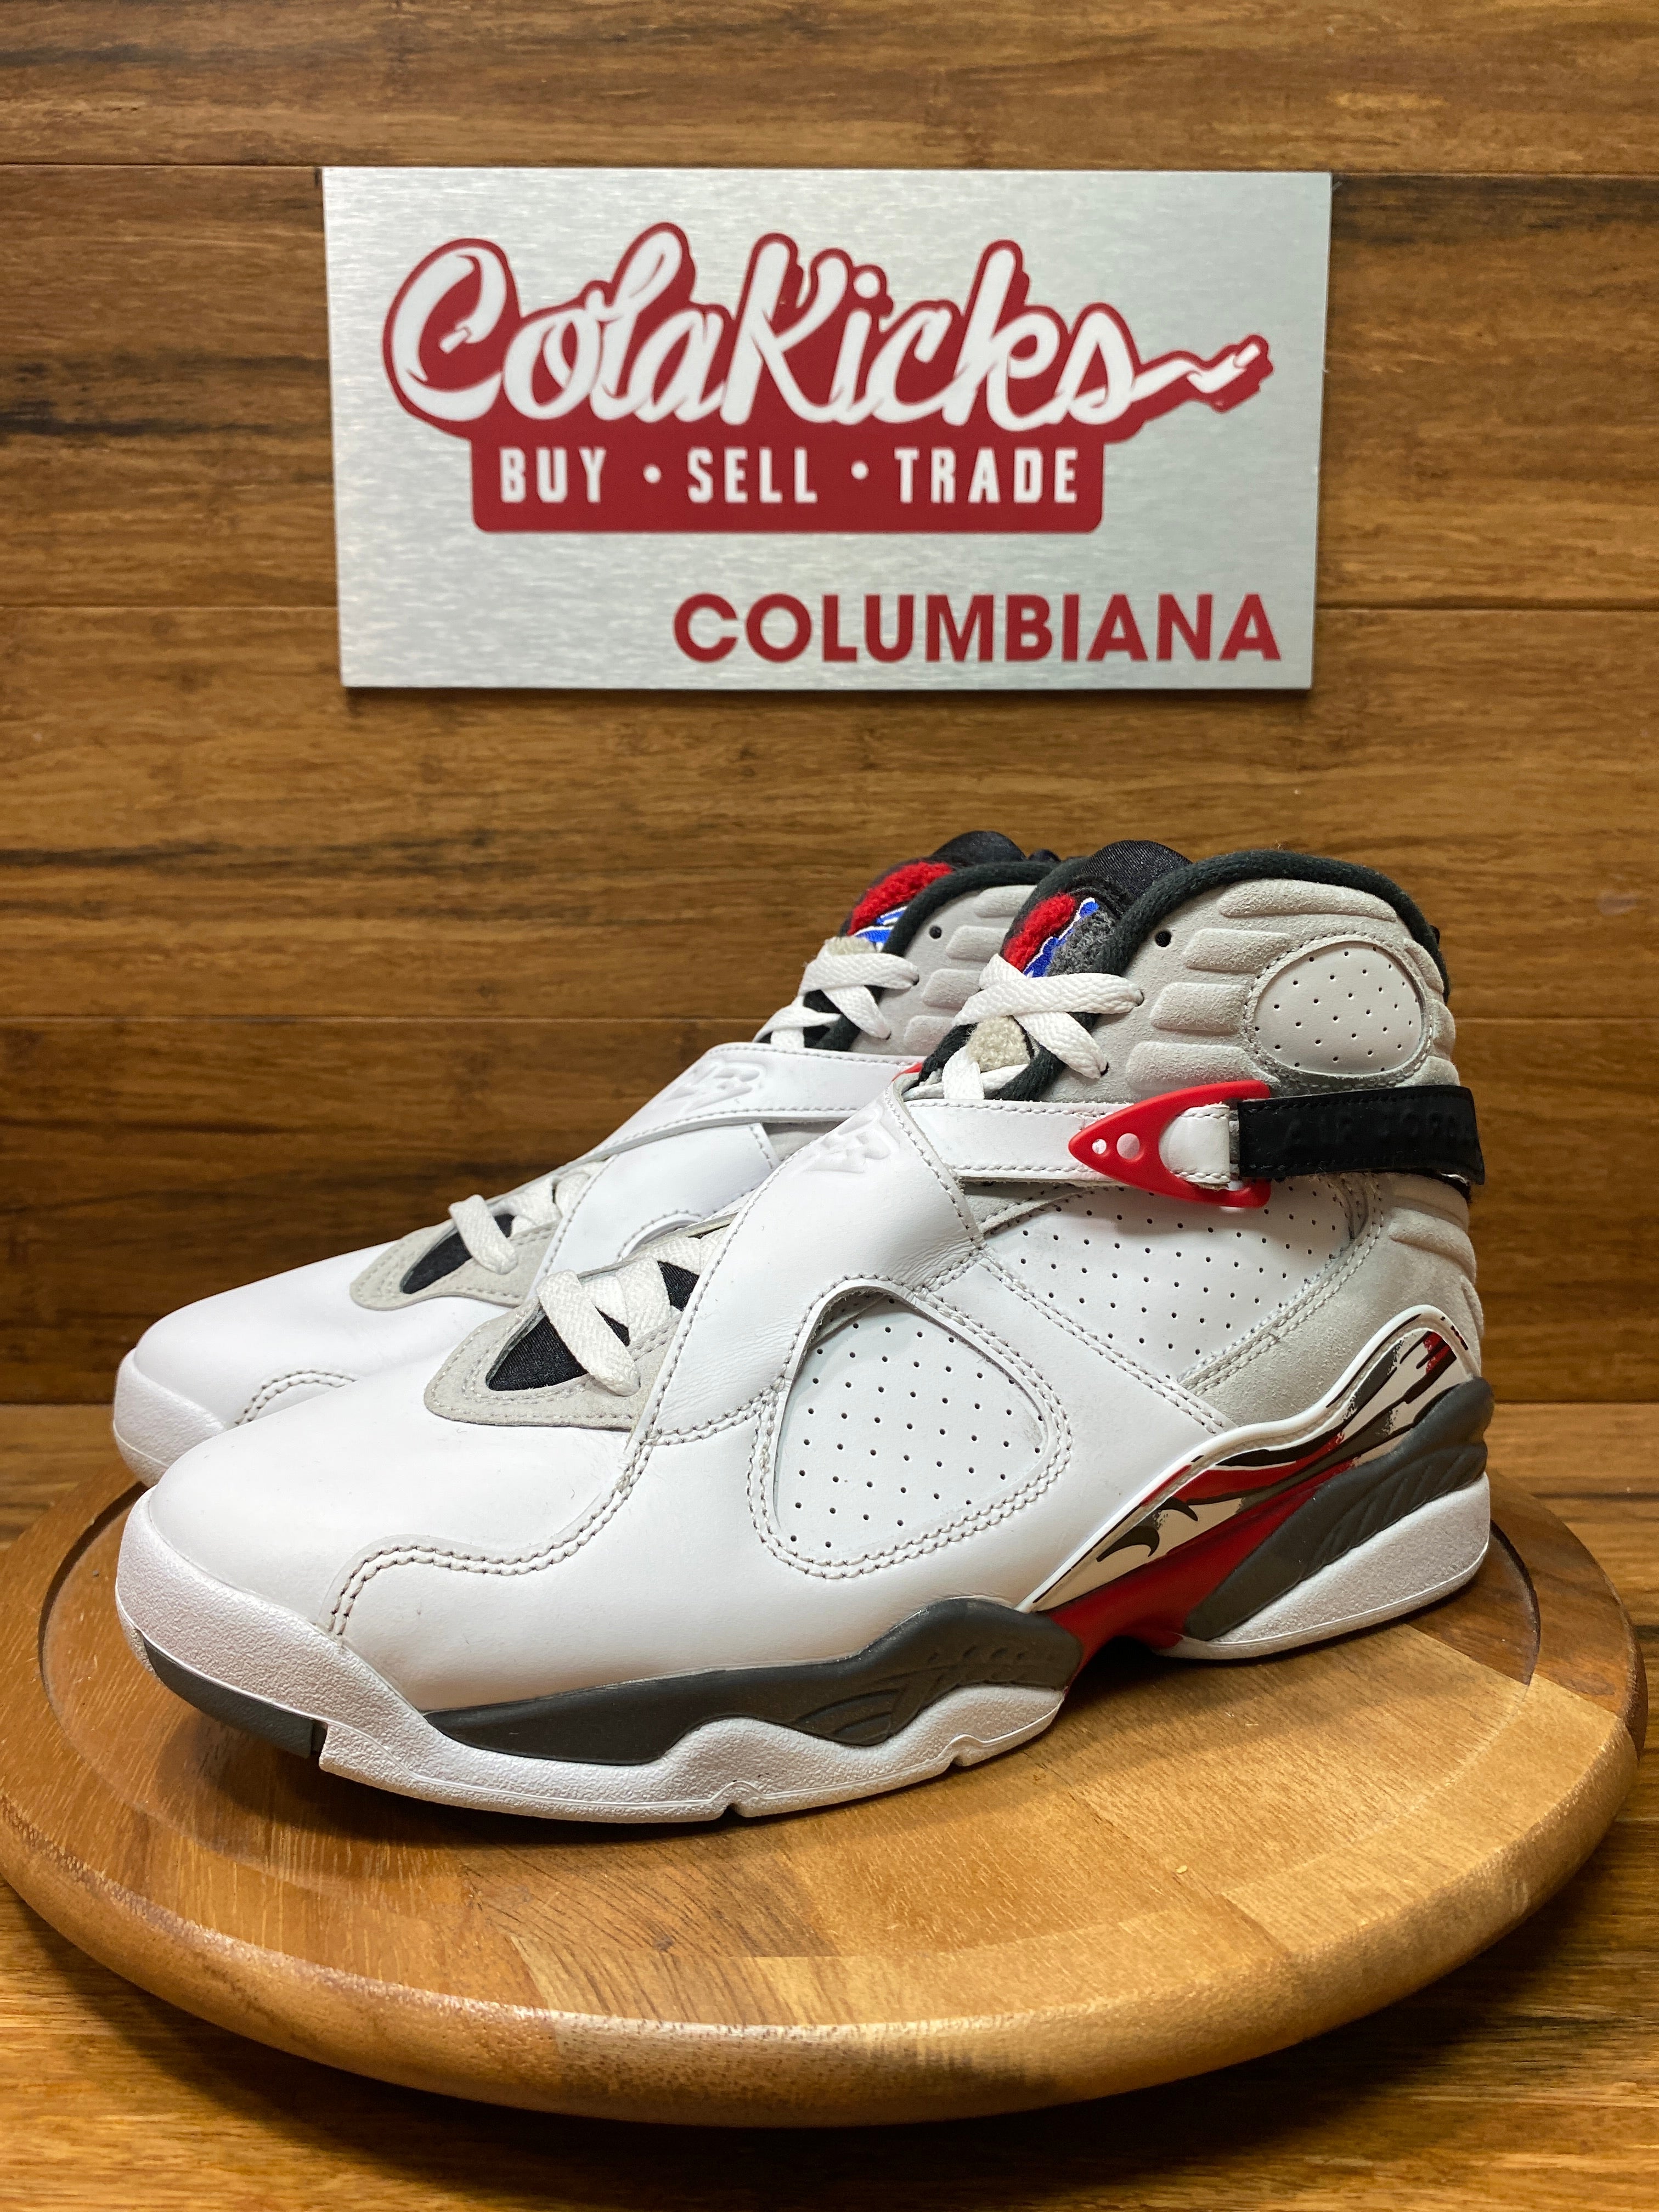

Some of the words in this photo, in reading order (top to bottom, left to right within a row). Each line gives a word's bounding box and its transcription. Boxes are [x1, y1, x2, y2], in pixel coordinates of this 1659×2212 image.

[386, 224, 1266, 432] ColaKicks
[500, 447, 606, 503] BUY
[687, 447, 818, 504] SELL
[894, 447, 1078, 504] TRADE
[674, 593, 1280, 662] COLUMBIANA
